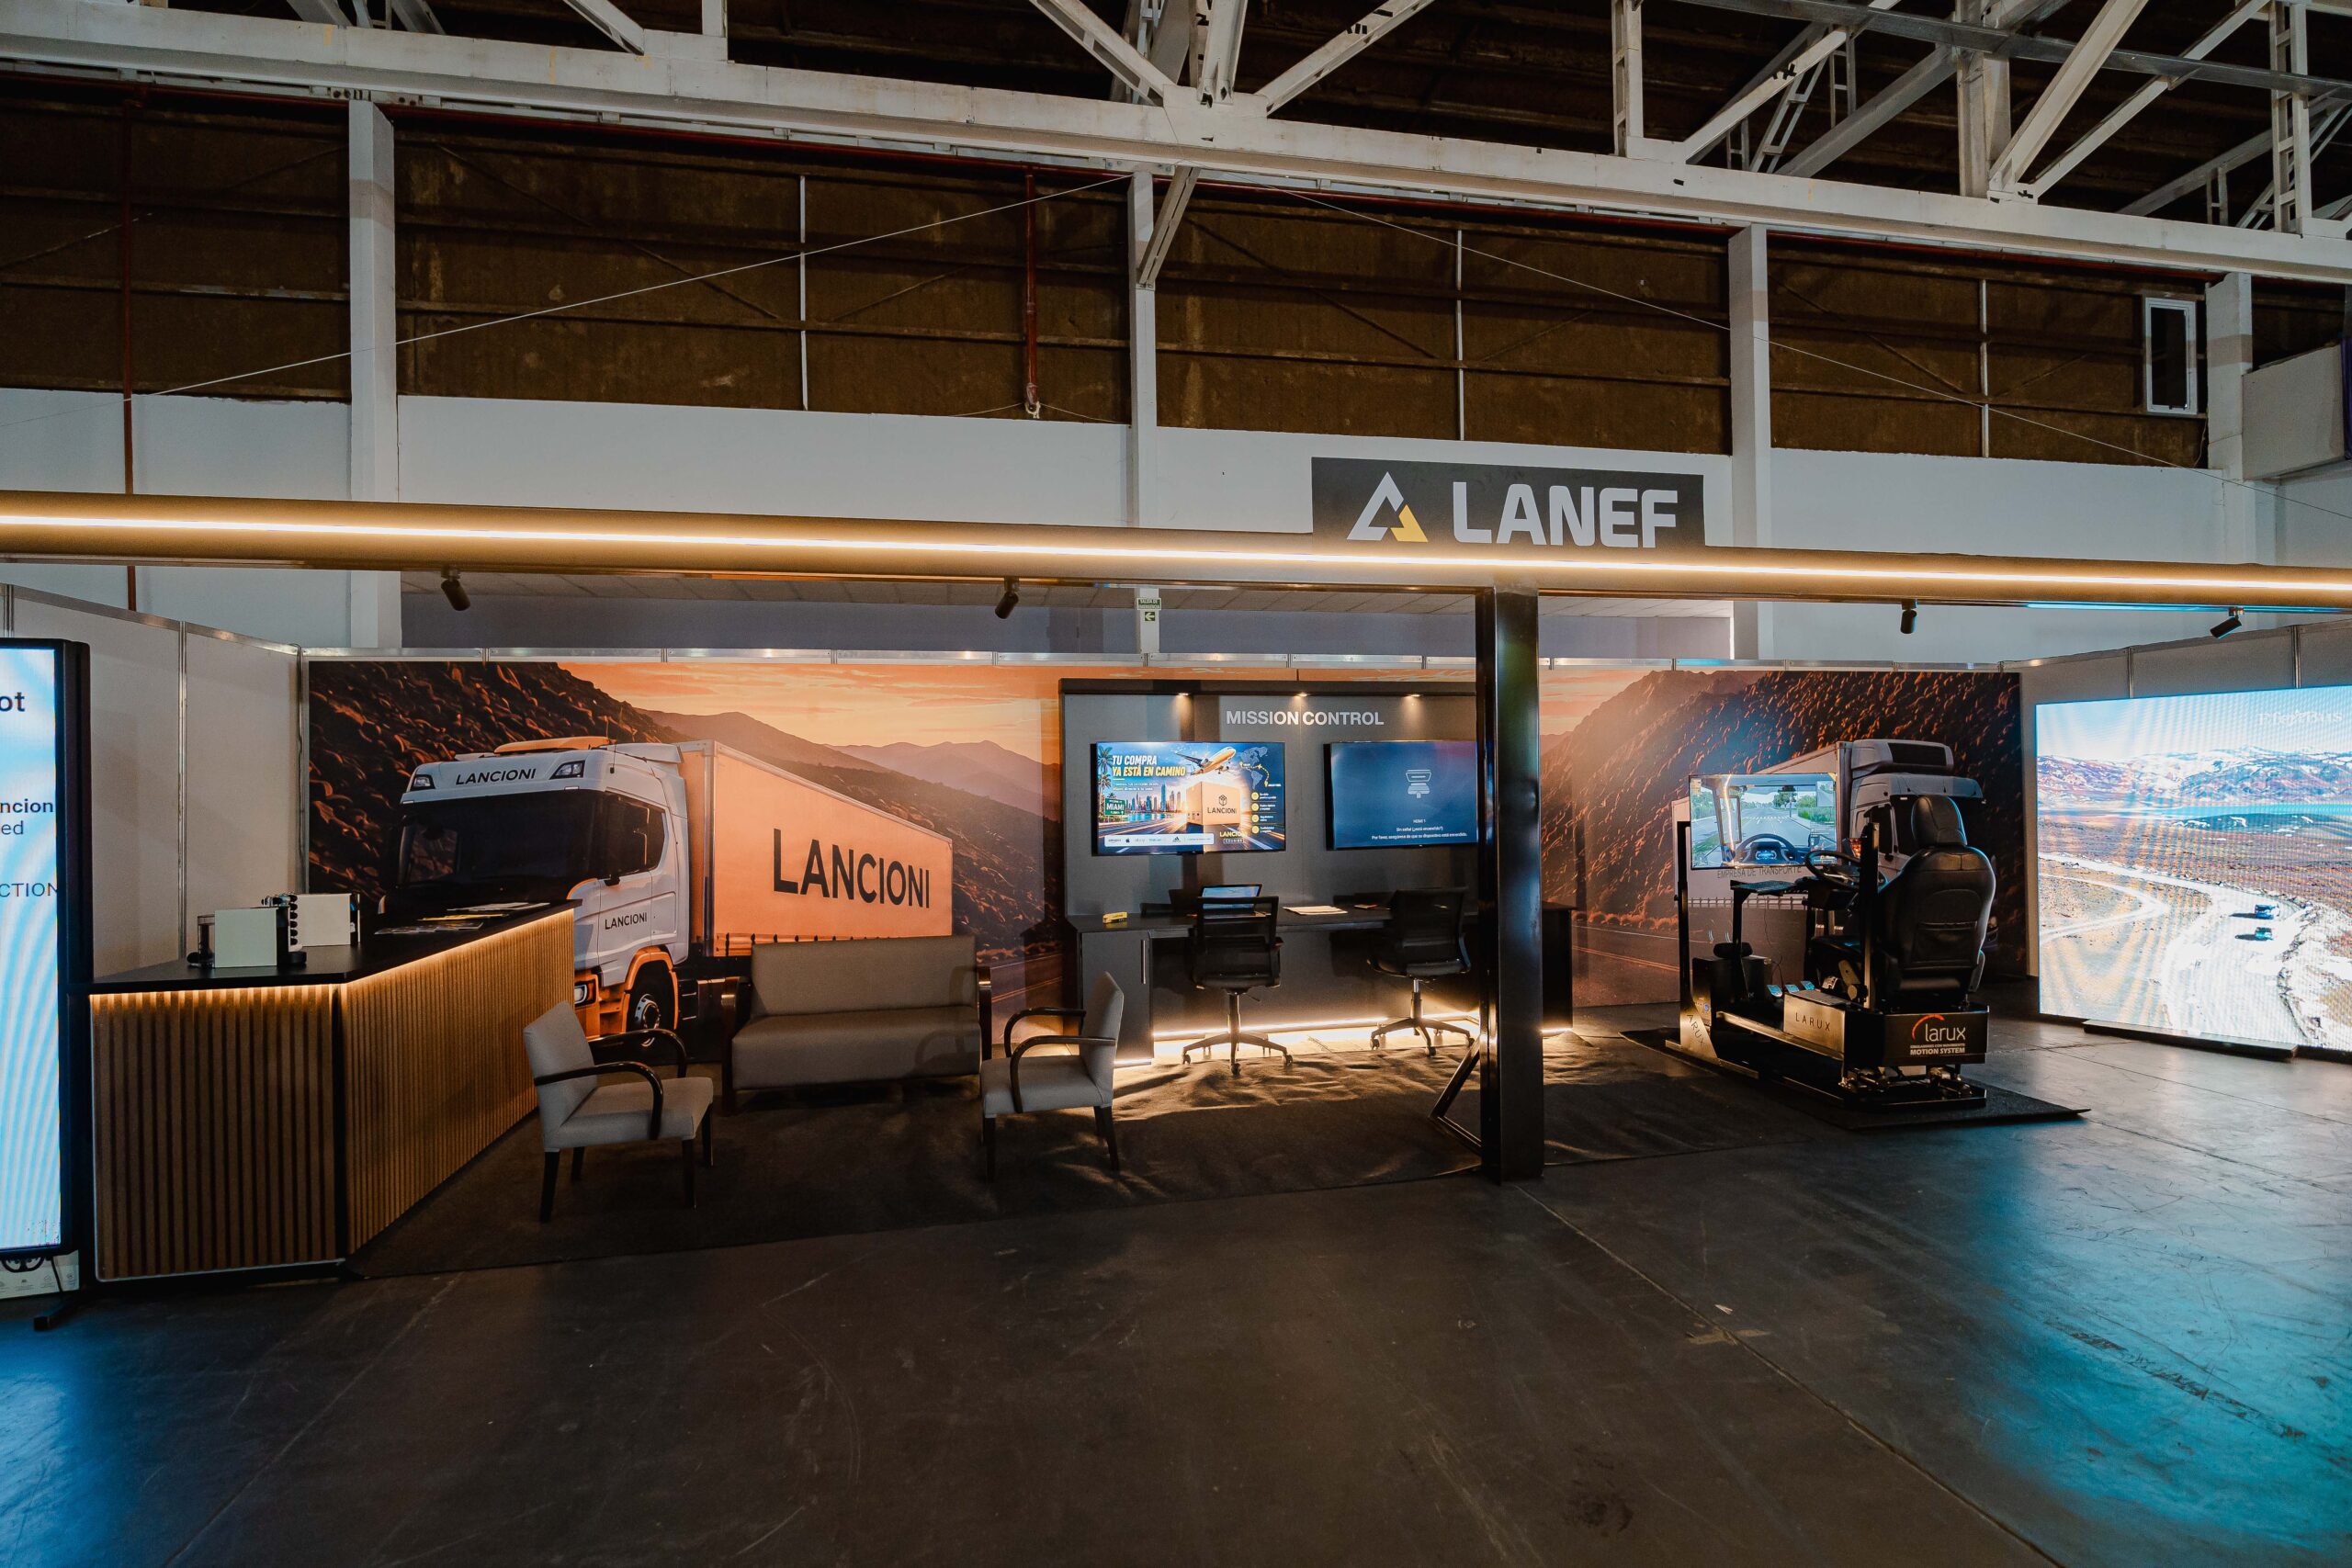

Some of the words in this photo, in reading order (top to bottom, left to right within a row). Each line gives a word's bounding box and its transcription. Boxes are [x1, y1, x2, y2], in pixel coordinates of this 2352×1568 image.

[1453, 481, 1679, 548] LANEF
[1226, 710, 1300, 726] MISSION
[1302, 711, 1385, 726] CONTROL
[1112, 755, 1122, 765] TU
[1124, 755, 1158, 765] COMPRA
[456, 768, 537, 785] LANCIONI
[1112, 766, 1122, 776] YA
[1143, 766, 1154, 777] EN
[1155, 765, 1186, 776] CAMINO
[1106, 803, 1125, 811] MIAMI
[773, 828, 930, 908] LANCIONI
[1717, 868, 1746, 878] EMPRESA
[1758, 865, 1802, 875] TRANSPORTE
[605, 912, 647, 930] LANCIONI
[1795, 1011, 1831, 1032] LARUX
[1925, 1022, 1966, 1042] larux
[1910, 1047, 1939, 1055] MOTION
[1939, 1046, 1965, 1055] SYSTEM
